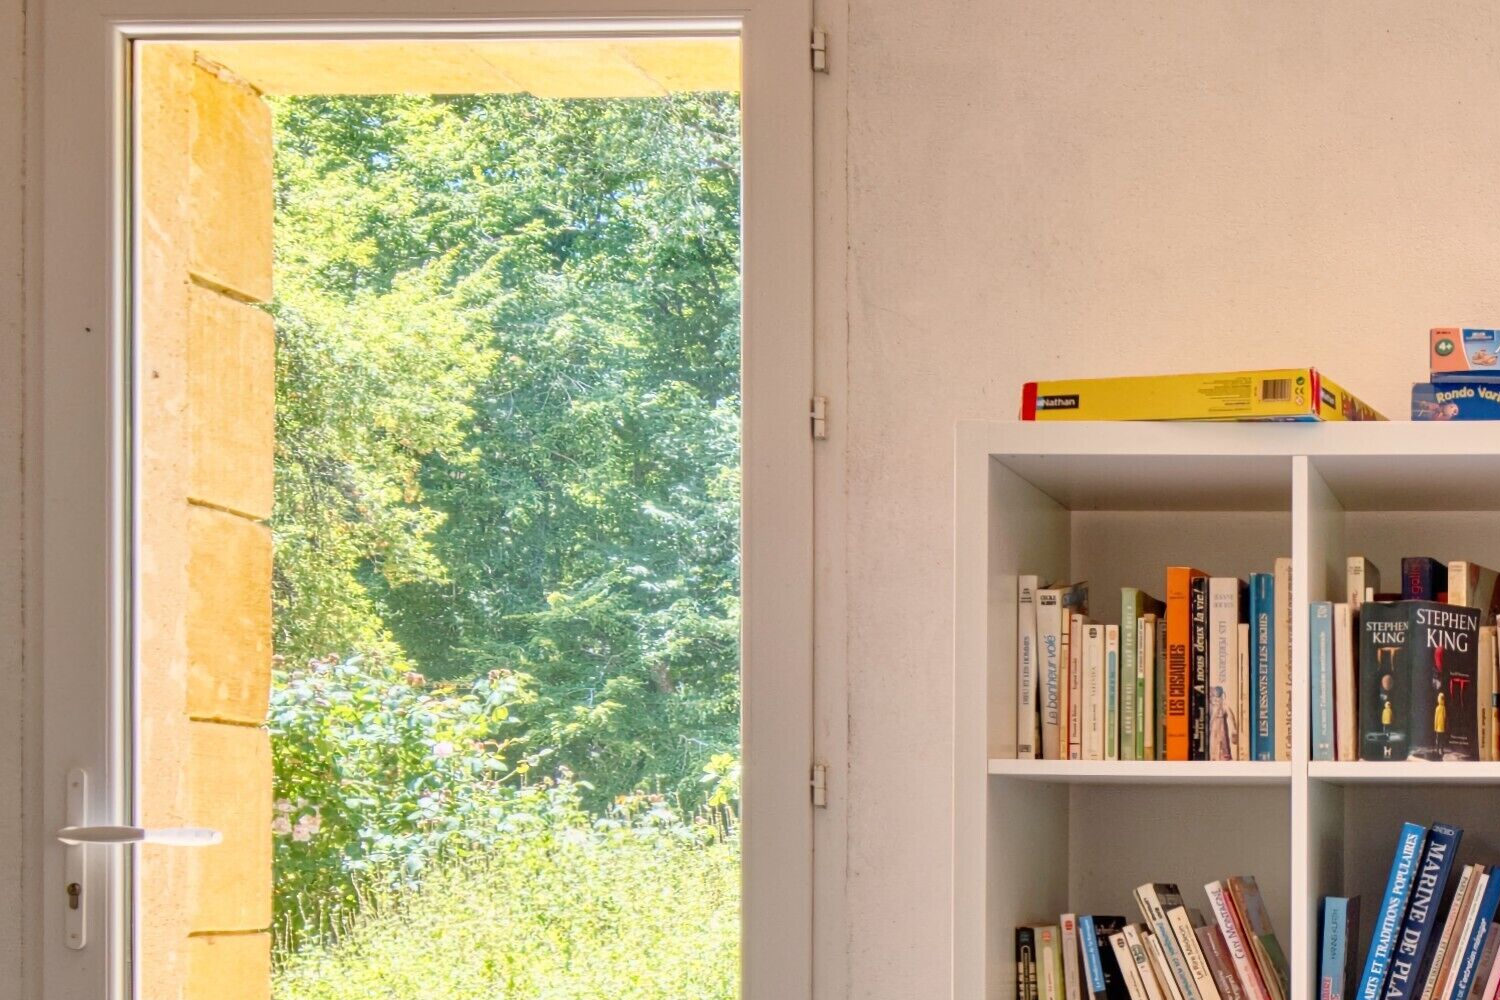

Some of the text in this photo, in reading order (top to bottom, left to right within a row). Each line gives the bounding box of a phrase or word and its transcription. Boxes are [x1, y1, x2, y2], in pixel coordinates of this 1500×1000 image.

[1438, 343, 1453, 351] 4+
[1041, 396, 1076, 407] Nathan
[1436, 386, 1475, 404] Rondo
[1193, 611, 1204, 623] la
[1218, 620, 1226, 634] LES
[1366, 621, 1409, 632] STEPHEN
[1416, 609, 1478, 631] STEPHEN
[1193, 625, 1204, 652] deux
[1372, 632, 1405, 643] KING
[1427, 629, 1468, 652] KING
[1043, 634, 1057, 724] Le bonheur volé
[1169, 644, 1185, 716] LES COSAQUES
[1193, 655, 1205, 681] nous
[1258, 612, 1268, 736] LES PUISSANTS ET LES RICHES
[1391, 831, 1419, 896] POPULAIRES
[1407, 839, 1446, 924] MARINE
[1374, 895, 1401, 959] TRADITIONS
[1470, 916, 1488, 951] ménager
[1228, 936, 1246, 961] GUY
[1328, 936, 1338, 960] HANNS
[1398, 926, 1421, 956] DE
[1369, 959, 1384, 974] ET
[1457, 949, 1478, 990] l'entretien
[1456, 988, 1465, 998] DE
